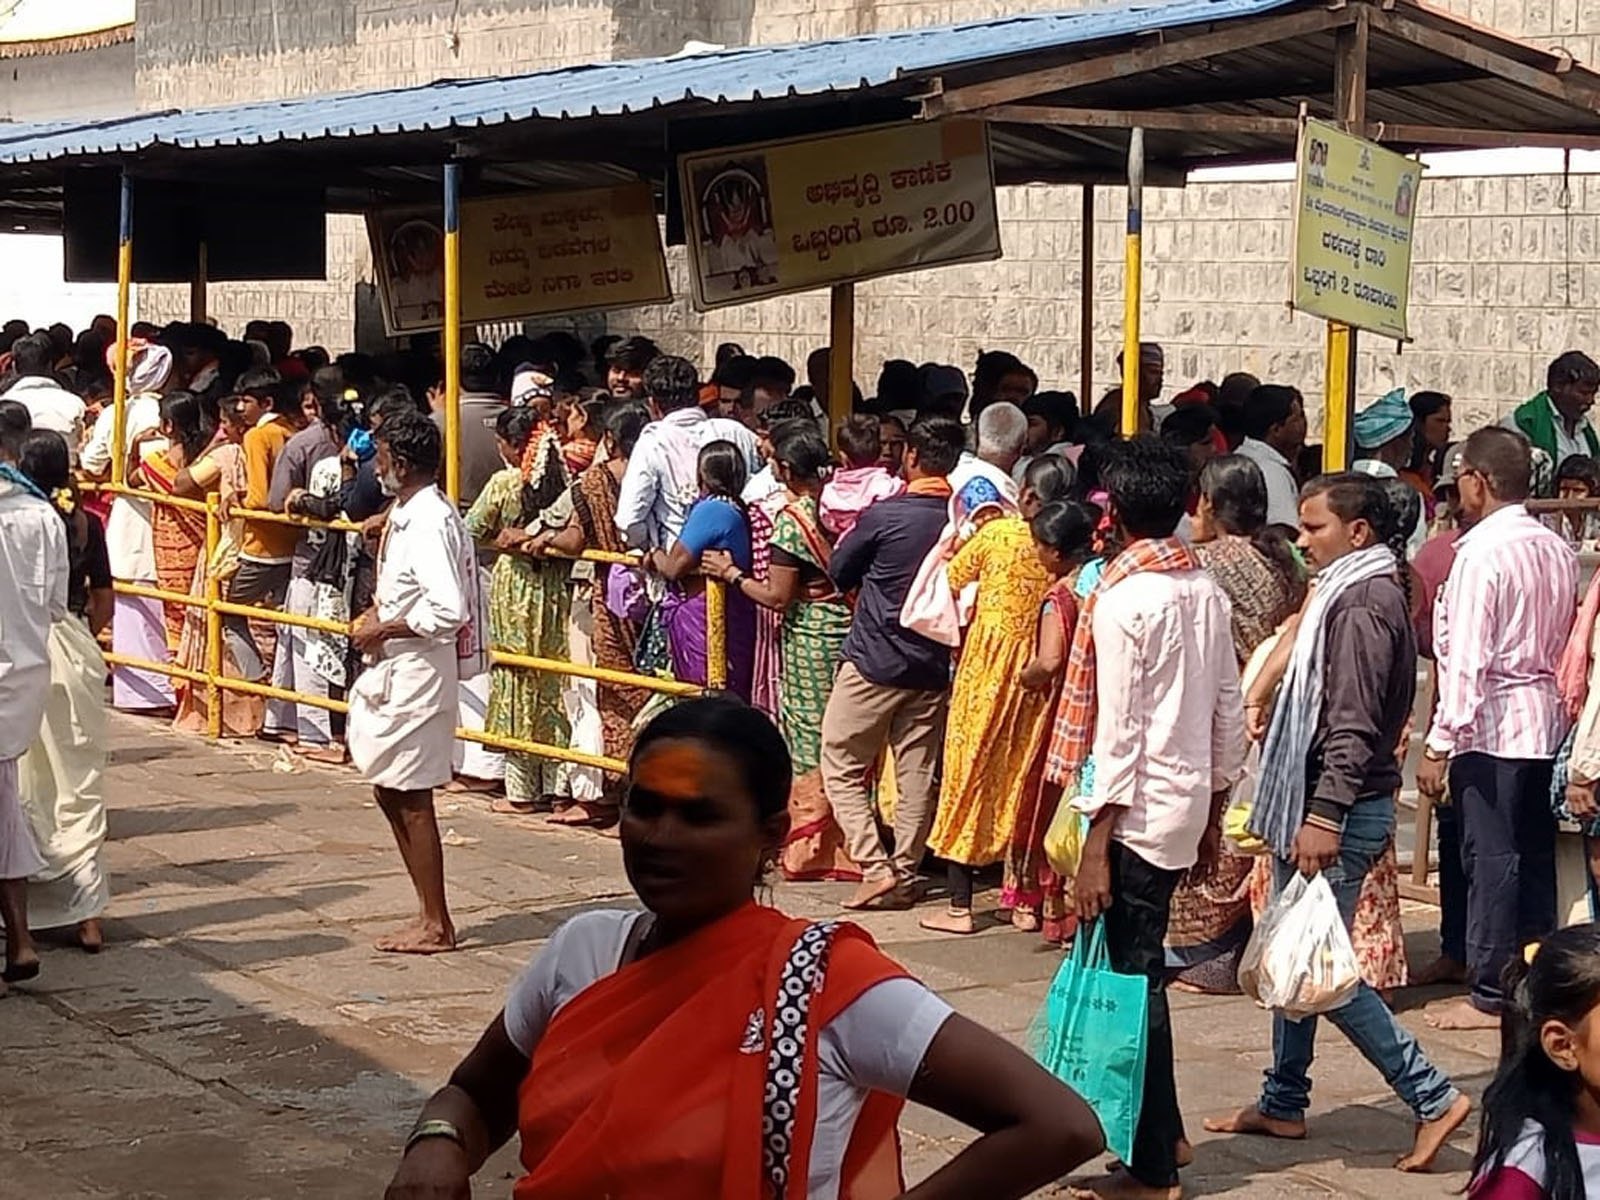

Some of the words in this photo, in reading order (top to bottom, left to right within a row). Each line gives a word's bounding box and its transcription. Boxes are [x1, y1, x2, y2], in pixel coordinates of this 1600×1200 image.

[792, 217, 862, 261] ಒಬ್ಬರಿಗೆ
[872, 214, 913, 238] ರೂ.
[923, 200, 975, 229] 2.00
[1322, 230, 1361, 270] ದರ್ಶನಕ್ಕೆ
[1365, 247, 1386, 267] ದಾರಿ
[484, 278, 532, 299] ಮೇಲೆ
[542, 274, 582, 294] ನಿಗಾ
[1304, 266, 1337, 296] ಒಬ್ಬರಿಗೆ
[1341, 275, 1349, 294] 2
